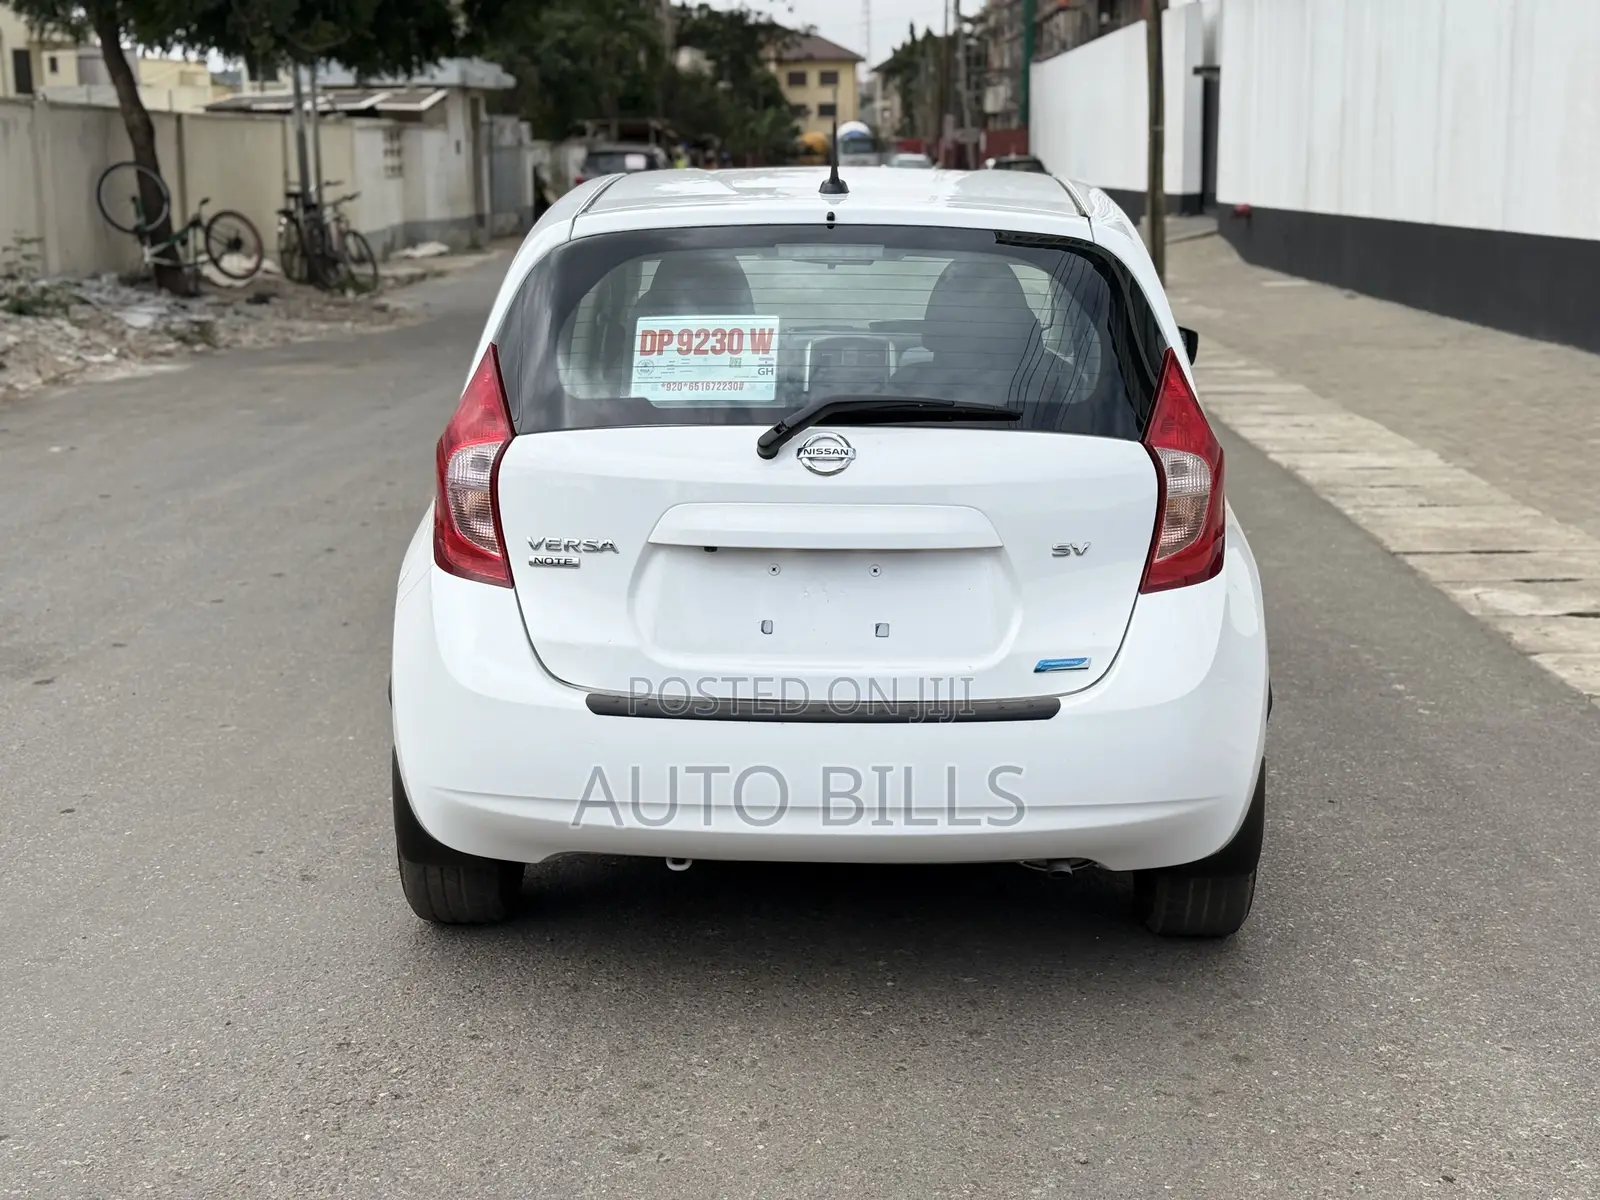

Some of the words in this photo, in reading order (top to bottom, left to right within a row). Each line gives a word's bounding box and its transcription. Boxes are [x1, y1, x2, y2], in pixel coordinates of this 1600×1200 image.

[639, 329, 674, 356] DP
[677, 328, 745, 356] 9230
[750, 328, 775, 355] W
[757, 367, 774, 376] GH
[803, 448, 849, 456] NISSAN
[526, 536, 620, 555] VERSA
[1051, 541, 1091, 558] SV
[533, 557, 574, 566] NOTE
